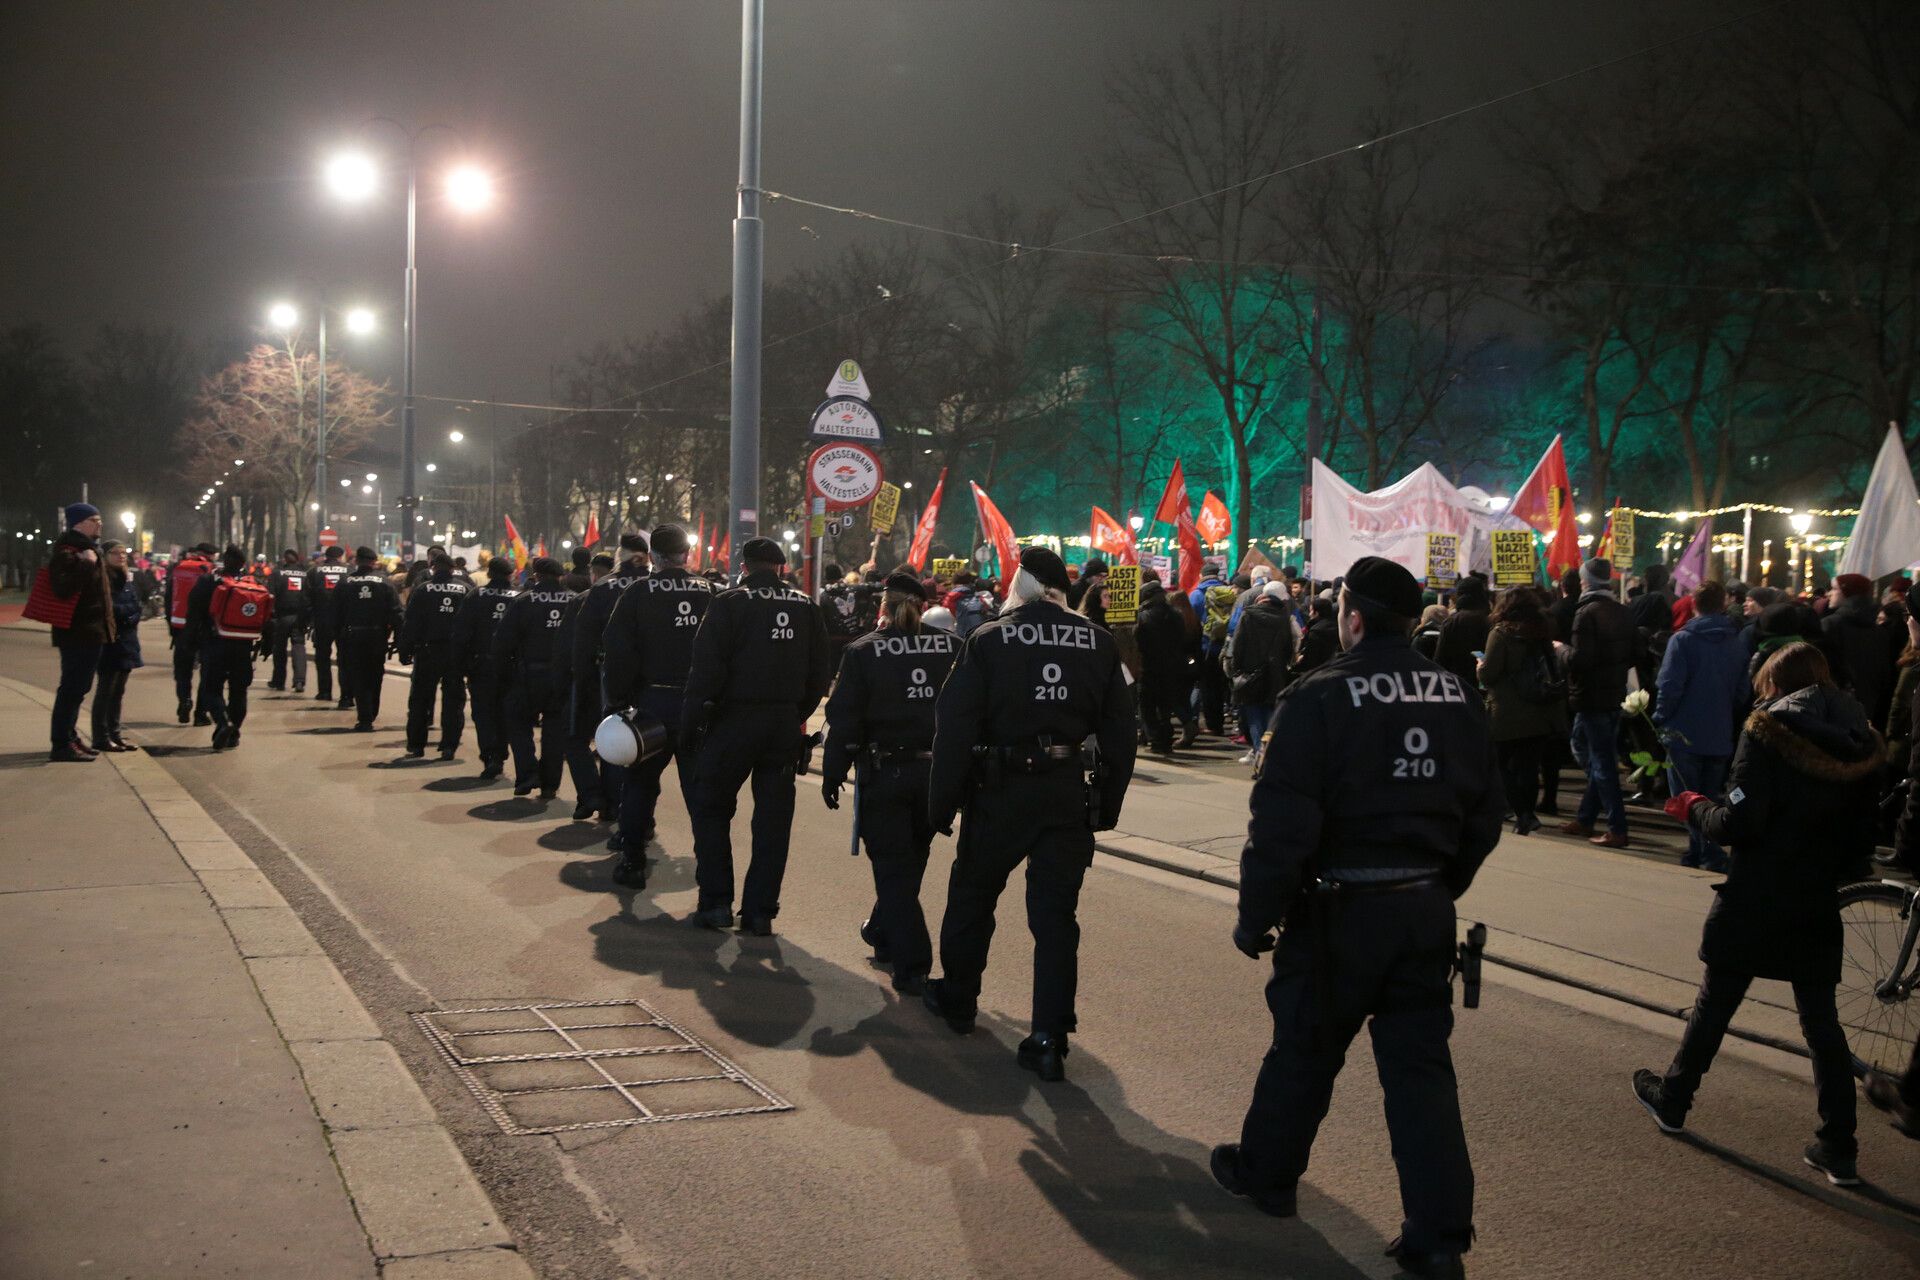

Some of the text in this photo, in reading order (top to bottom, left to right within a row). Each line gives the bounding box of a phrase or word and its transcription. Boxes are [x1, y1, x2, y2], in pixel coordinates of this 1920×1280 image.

[845, 364, 855, 378] H
[828, 402, 868, 420] AUTOBUS
[820, 425, 874, 437] HALTESTELLE
[819, 449, 873, 473] STRASSENBAHN
[820, 478, 869, 498] HALTESTELLE
[843, 515, 853, 527] D
[831, 523, 838, 535] 1
[1429, 535, 1456, 547] LASST
[1495, 532, 1529, 543] LASST
[1430, 546, 1456, 558] NAZIS
[1496, 543, 1530, 554] NAZIS
[1429, 557, 1456, 569] NICHT
[1497, 553, 1530, 564] NICHT
[426, 583, 466, 595] POLIZEI
[440, 605, 454, 613] 210
[675, 615, 698, 626] 210
[771, 628, 794, 639] 210
[1001, 624, 1097, 650] POLIZEI
[873, 634, 952, 657] POLIZEI
[907, 686, 934, 698] 210
[1034, 685, 1068, 700] 210
[1346, 671, 1467, 707] POLIZEI
[1393, 758, 1436, 777] 210
